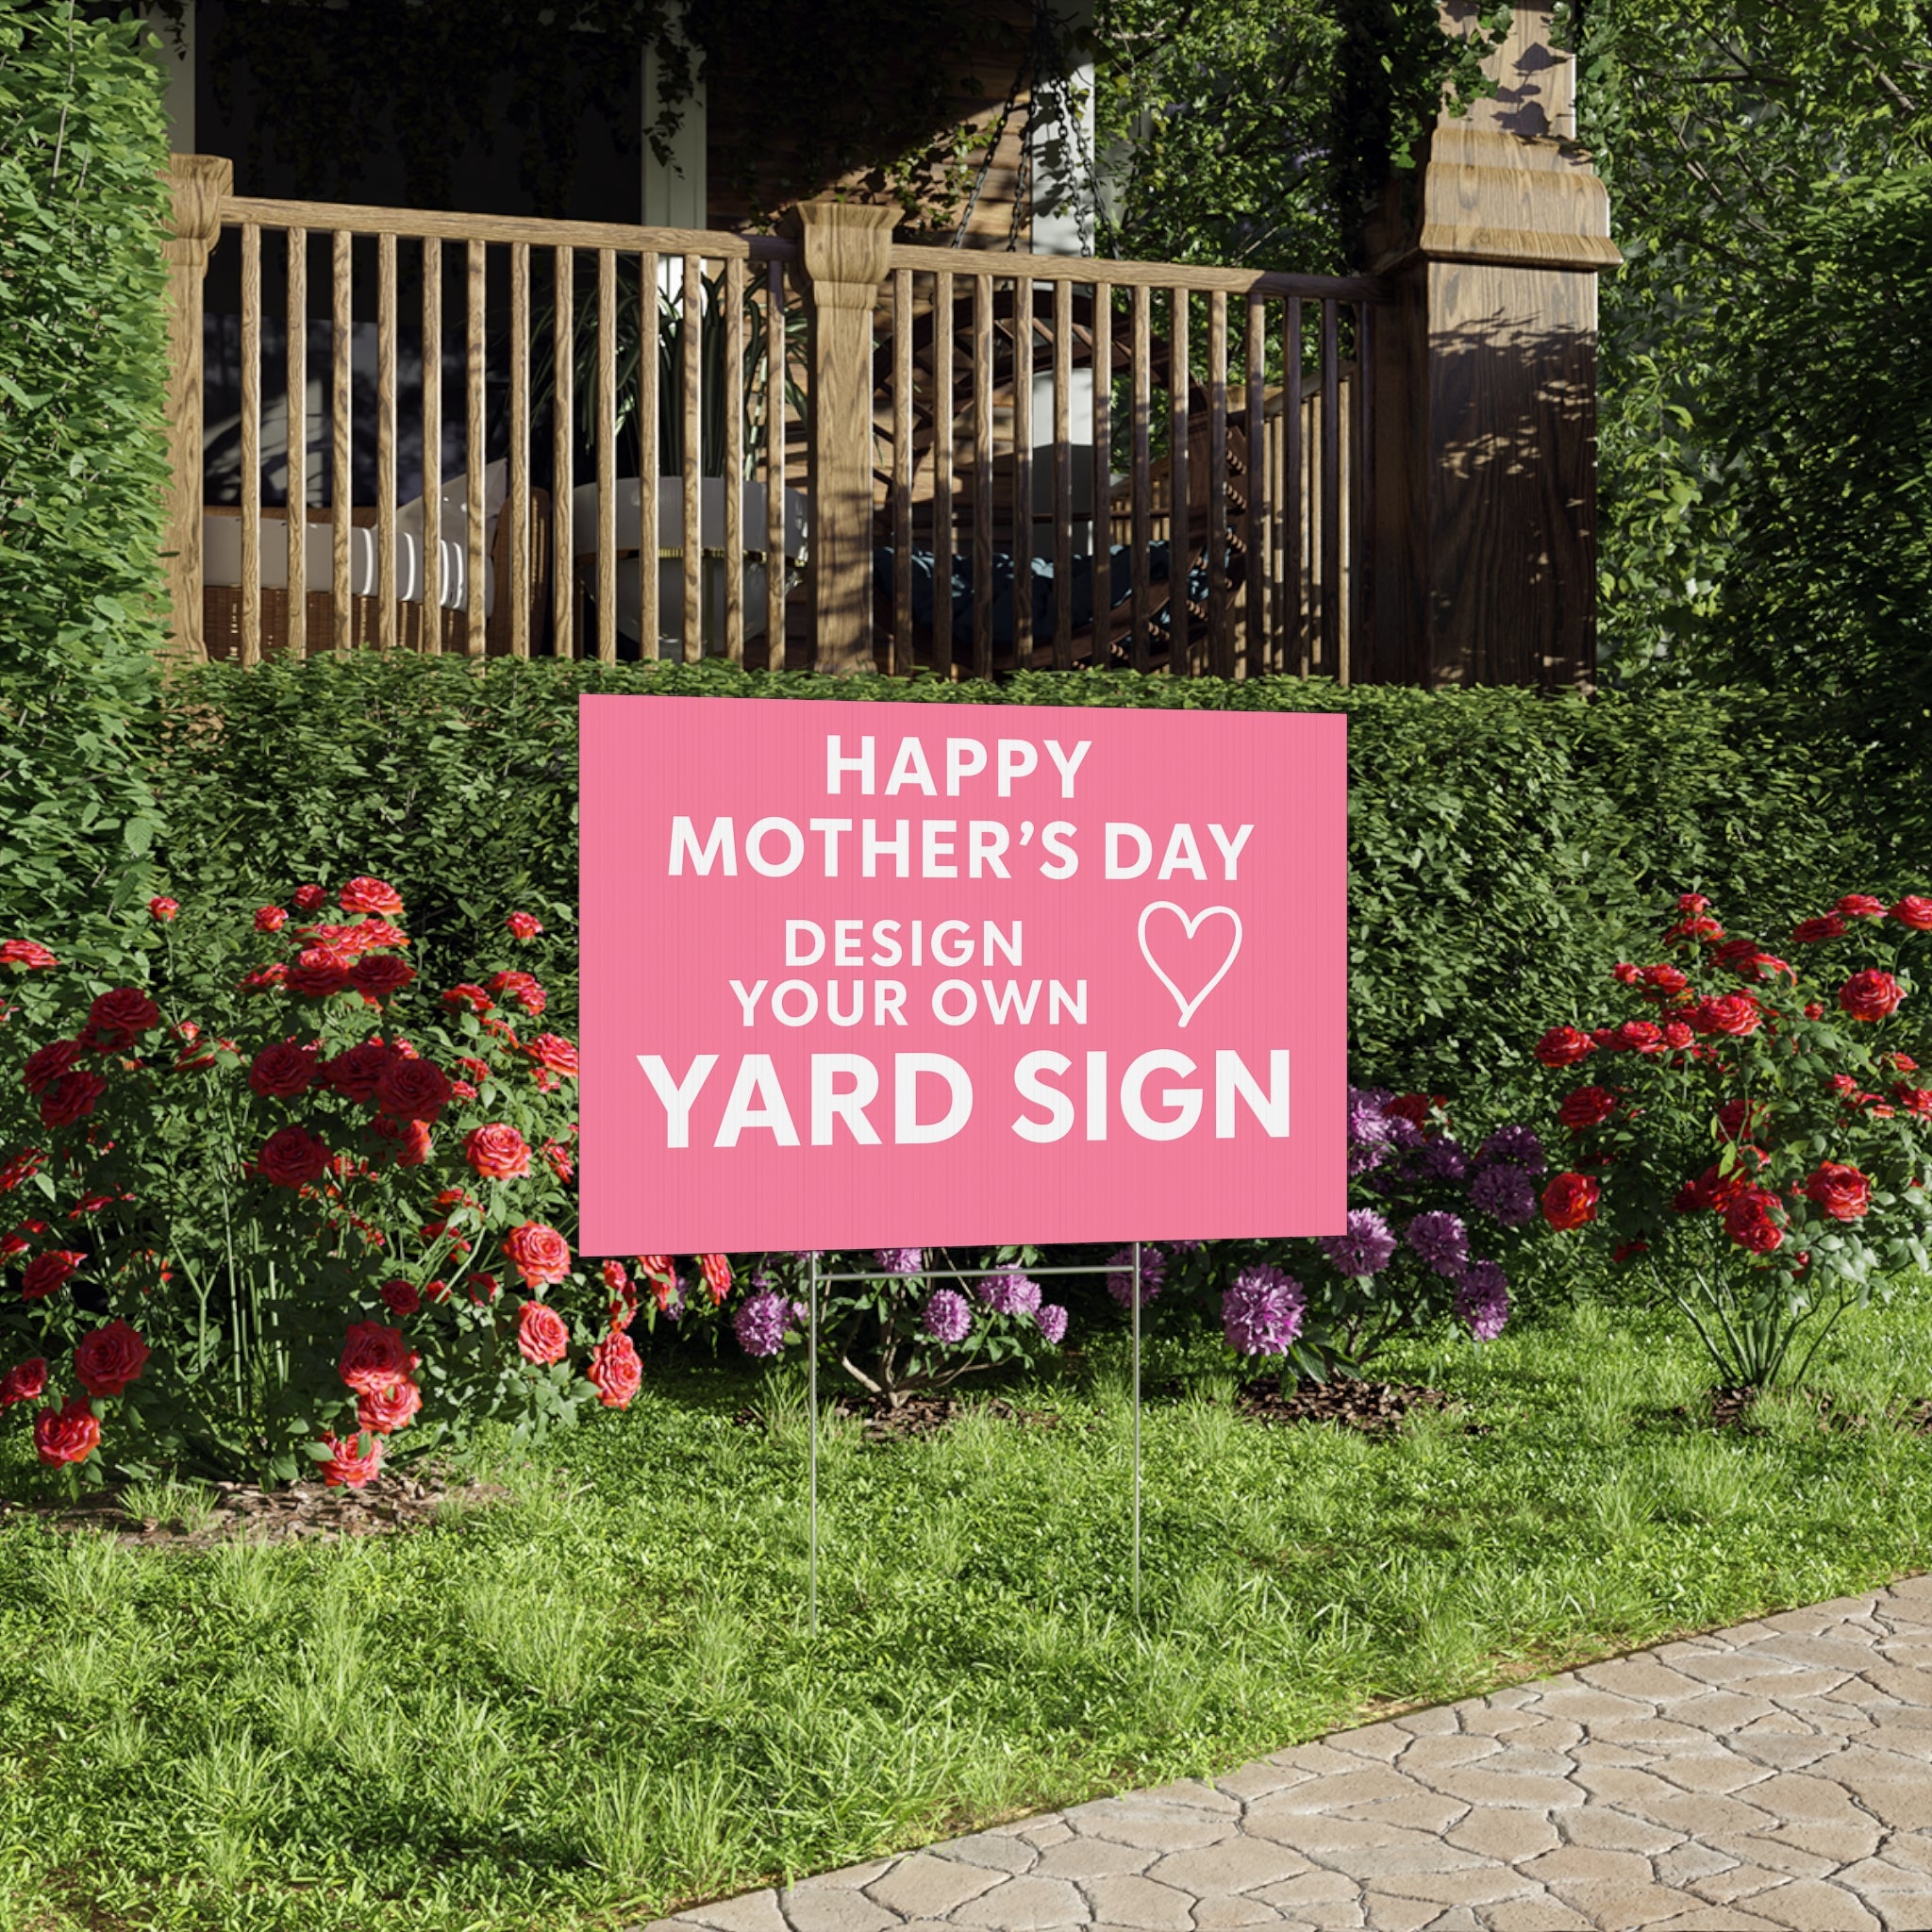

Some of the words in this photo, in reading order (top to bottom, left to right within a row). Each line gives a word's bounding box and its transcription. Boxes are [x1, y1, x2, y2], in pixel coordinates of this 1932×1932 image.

[826, 734, 1092, 799] HAPPY
[667, 815, 1080, 881] MOTHER’S
[1104, 822, 1255, 881] DAY
[785, 919, 1024, 968] DESIGN
[728, 978, 909, 1027] YOUR
[931, 978, 1088, 1026] OWN
[635, 1052, 974, 1149] YARD
[1010, 1048, 1291, 1144] SIGN
